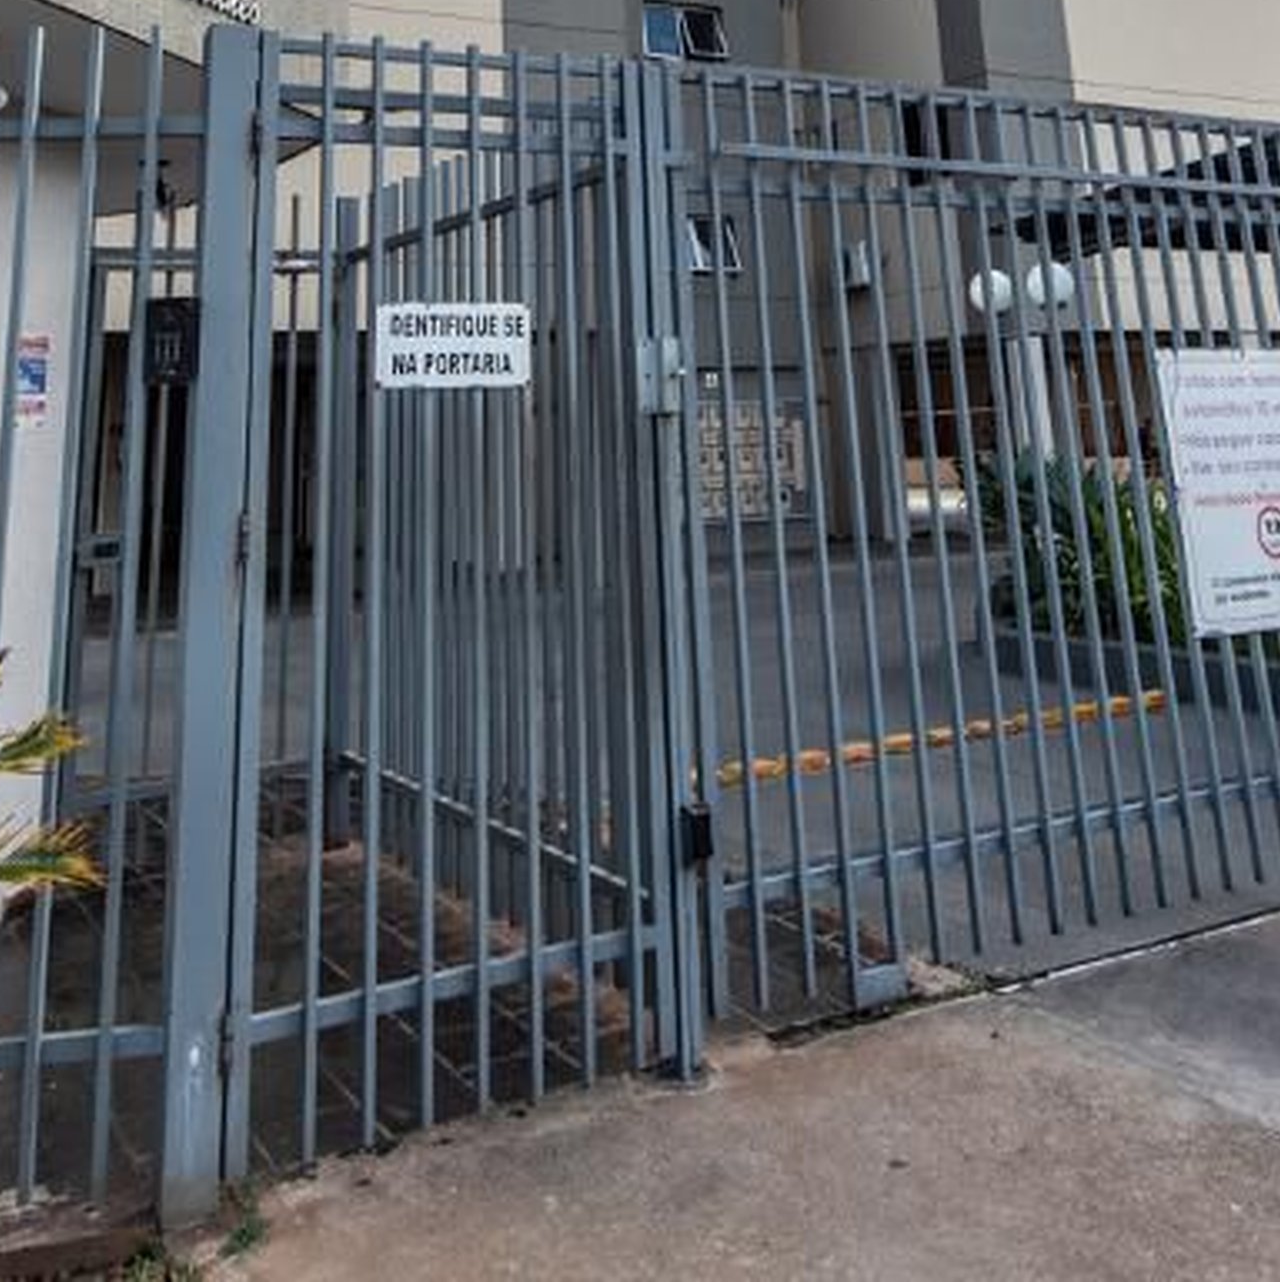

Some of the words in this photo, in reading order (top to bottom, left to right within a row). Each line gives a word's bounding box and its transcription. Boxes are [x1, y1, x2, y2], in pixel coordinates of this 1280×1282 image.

[503, 314, 526, 337] SE
[391, 352, 418, 375] NA
[423, 352, 515, 375] PORTARIA
